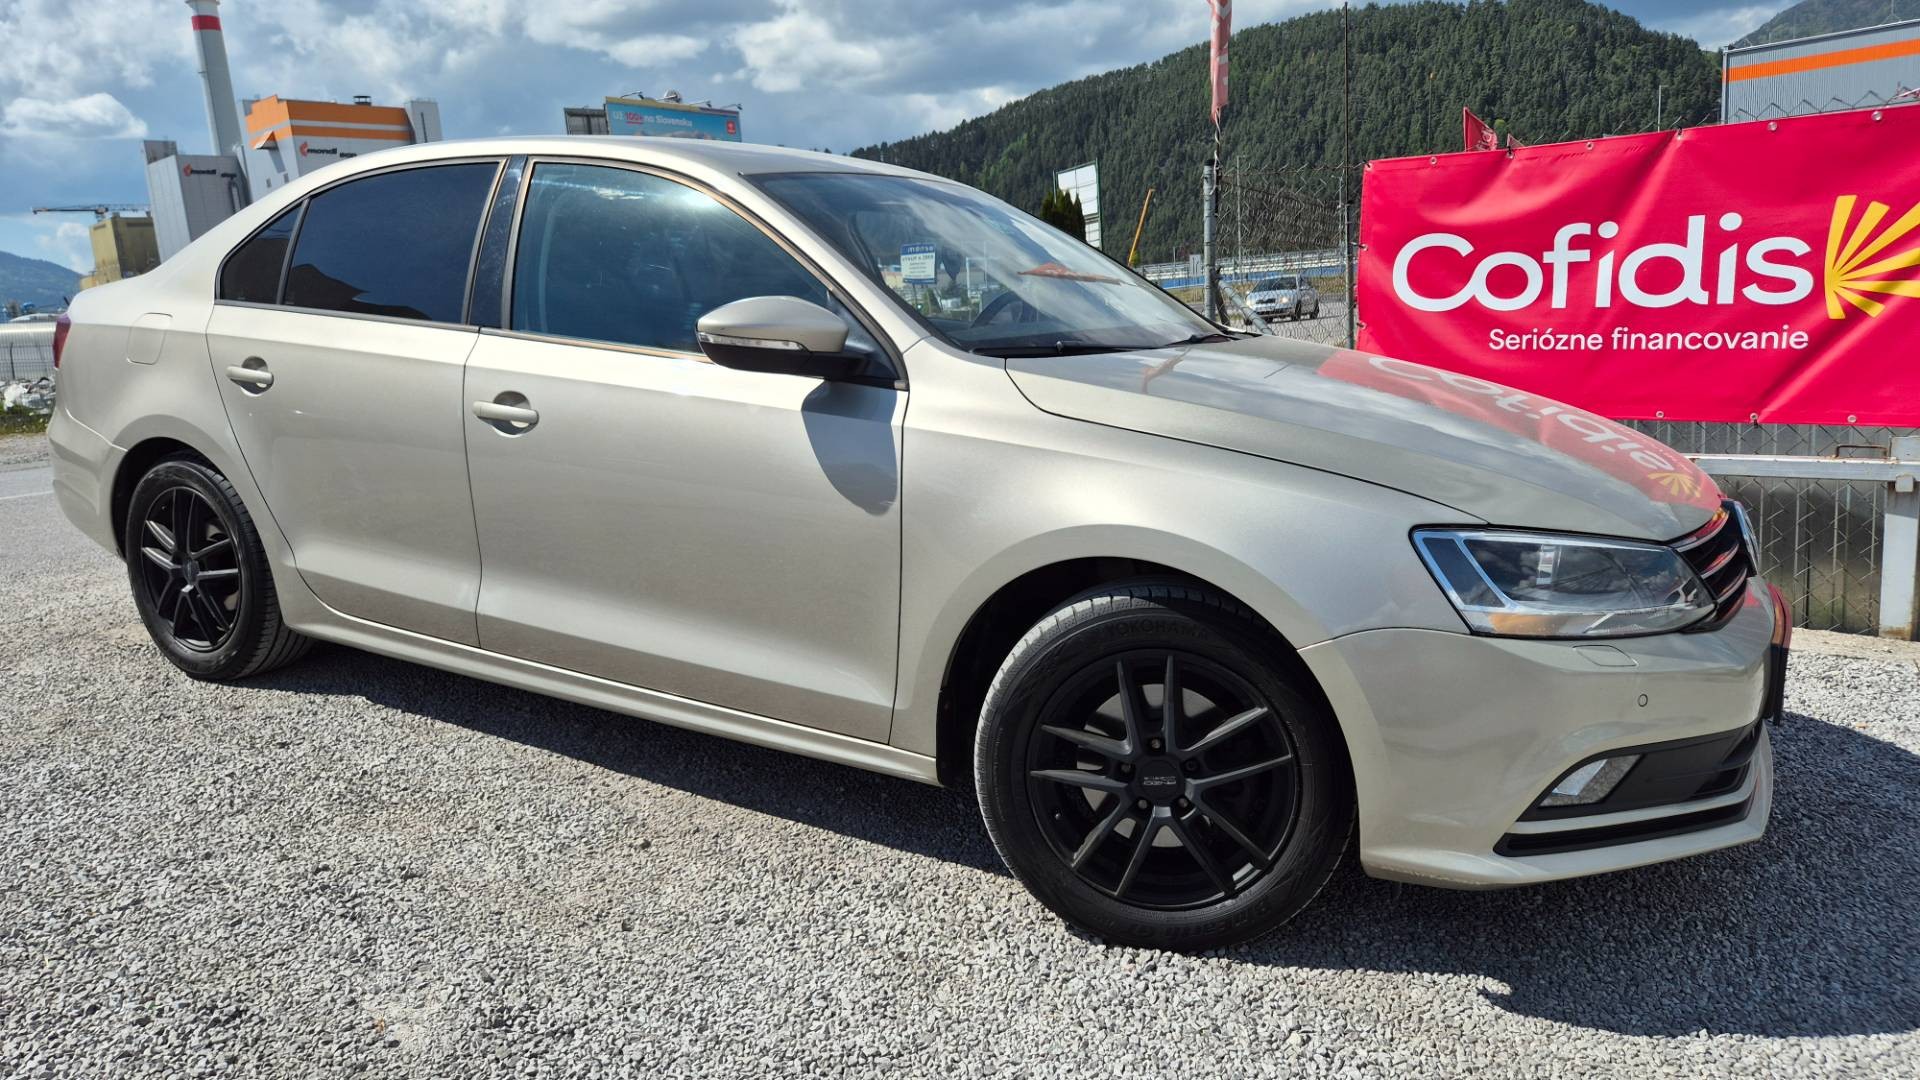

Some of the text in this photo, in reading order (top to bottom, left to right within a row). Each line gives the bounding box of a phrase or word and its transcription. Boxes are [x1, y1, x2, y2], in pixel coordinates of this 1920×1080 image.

[1393, 212, 1814, 312] Cofidis
[1489, 324, 1809, 351] Seriózne financovanie
